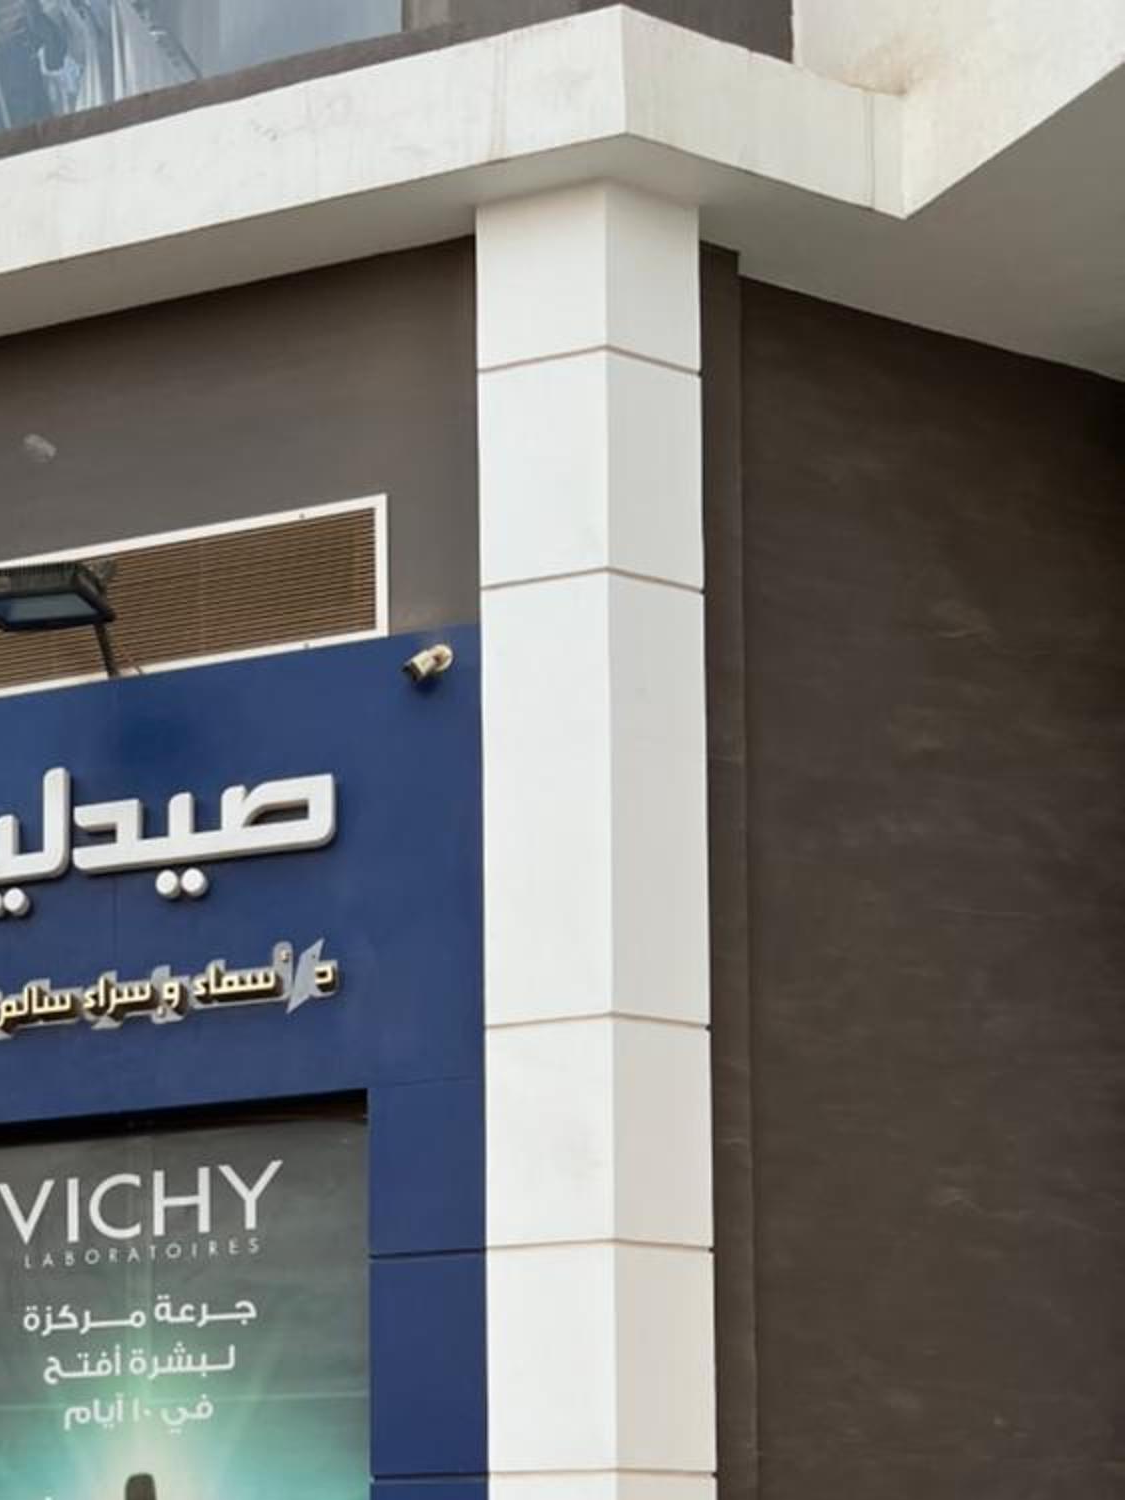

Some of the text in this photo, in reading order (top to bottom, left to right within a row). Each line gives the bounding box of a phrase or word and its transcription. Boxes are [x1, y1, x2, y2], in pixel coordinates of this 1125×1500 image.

[24, 1237, 261, 1269] LABORATOIRES
[23, 1295, 257, 1336] جرعة مركزة
[42, 1343, 236, 1385] لبشرة أفتح
[64, 1398, 124, 1430] أيام
[161, 1394, 214, 1433] في
